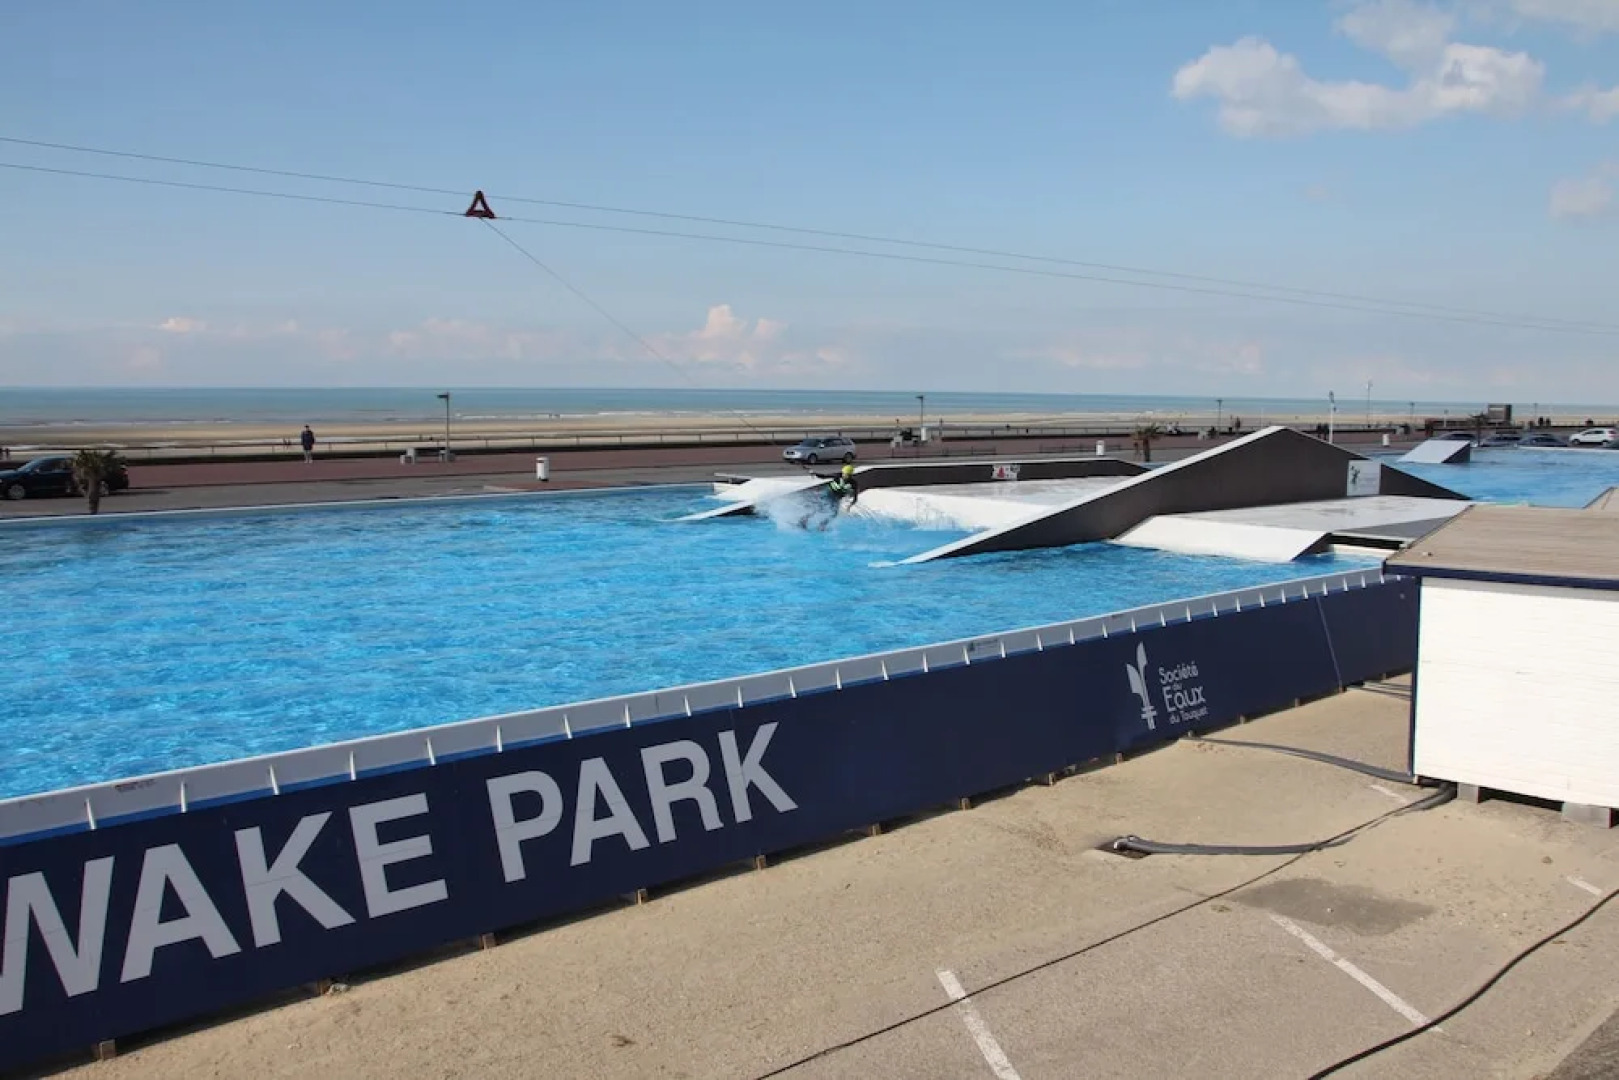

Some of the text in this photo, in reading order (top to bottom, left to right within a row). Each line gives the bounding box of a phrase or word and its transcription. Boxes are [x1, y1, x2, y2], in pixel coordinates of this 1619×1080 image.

[1158, 660, 1199, 684] Société
[1162, 685, 1207, 712] Eaux
[487, 722, 799, 883] PARK
